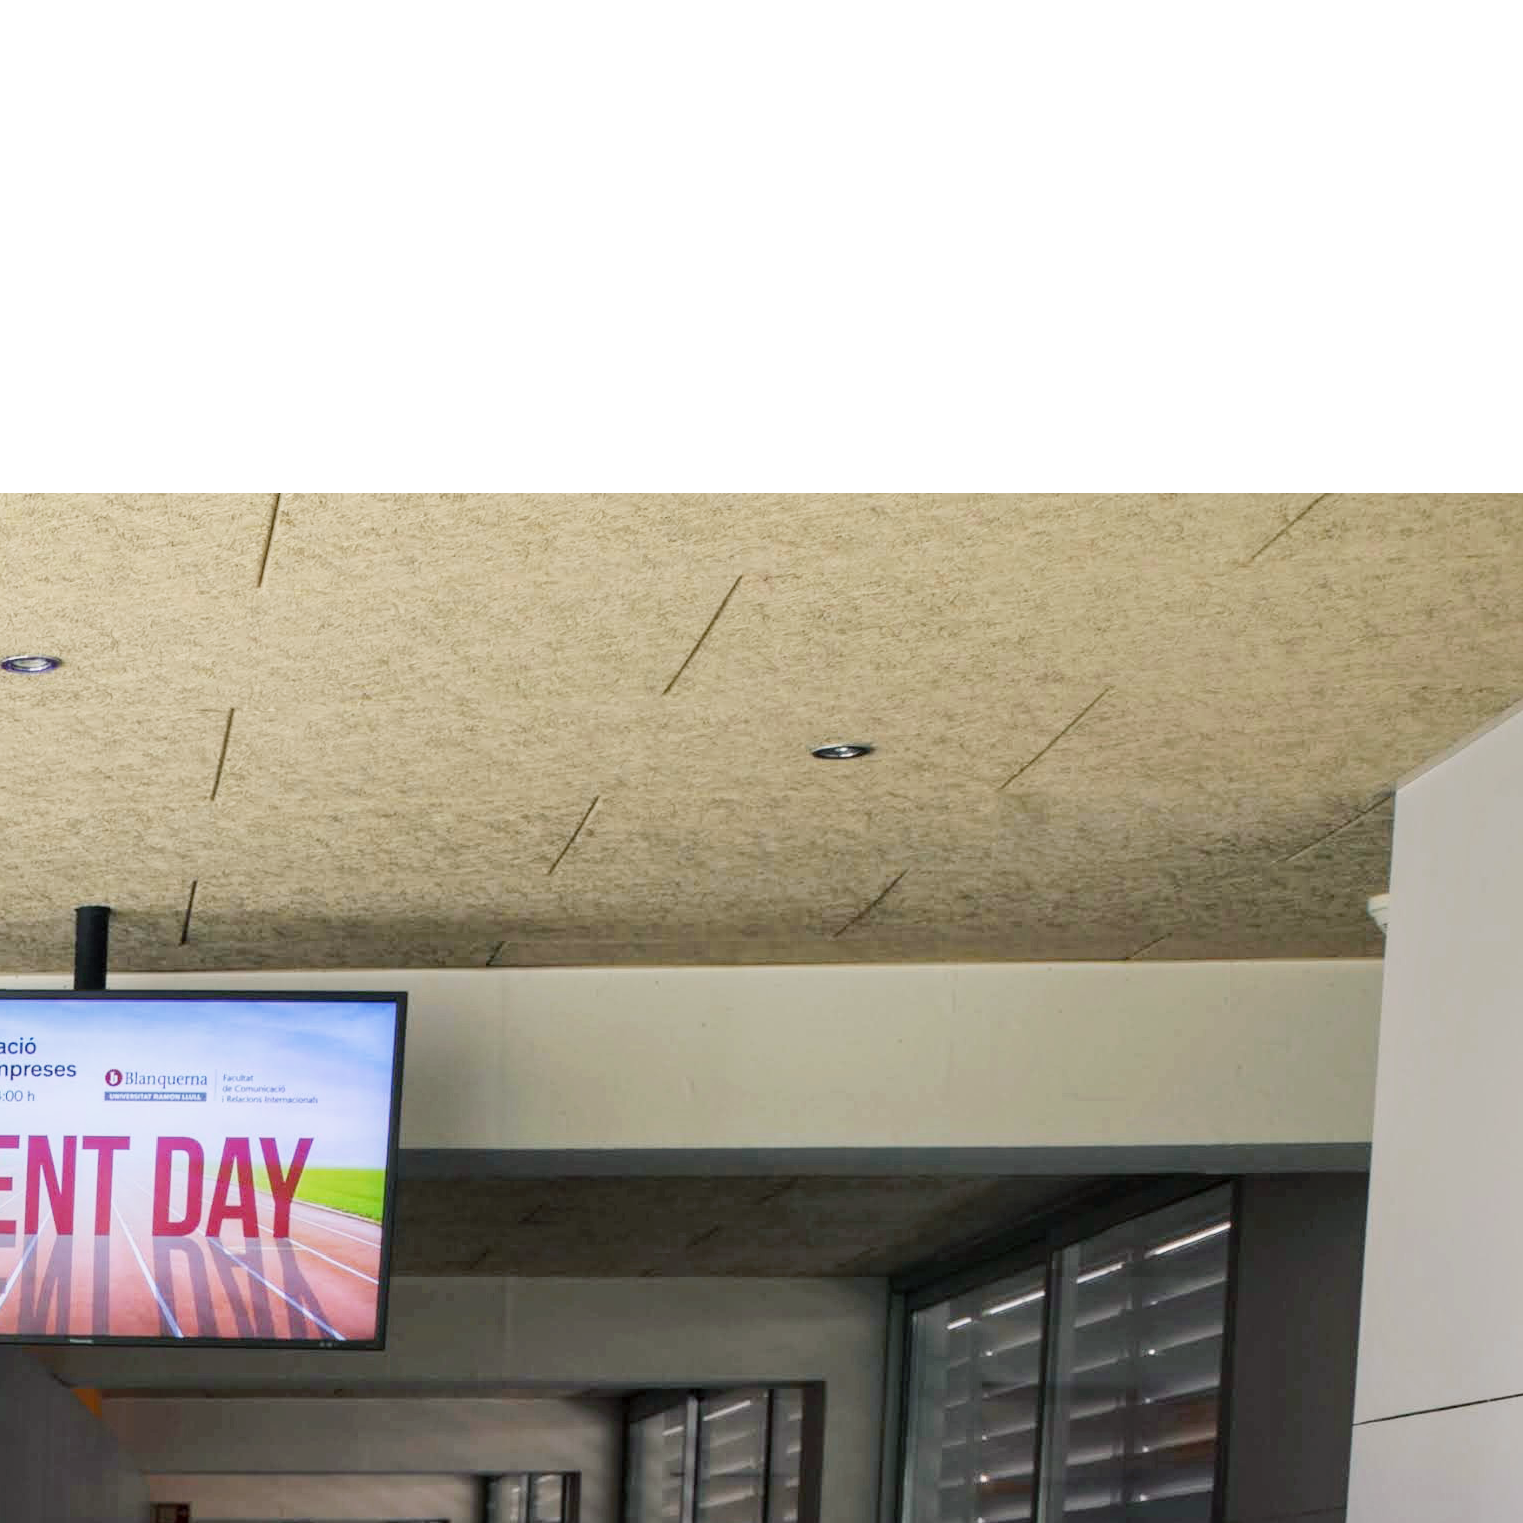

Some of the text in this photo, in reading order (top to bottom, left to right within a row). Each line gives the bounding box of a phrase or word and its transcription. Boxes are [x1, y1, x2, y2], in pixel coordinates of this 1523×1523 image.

[125, 1072, 207, 1089] Blanquerna
[27, 1090, 35, 1102] h
[152, 1136, 315, 1239] DAY
